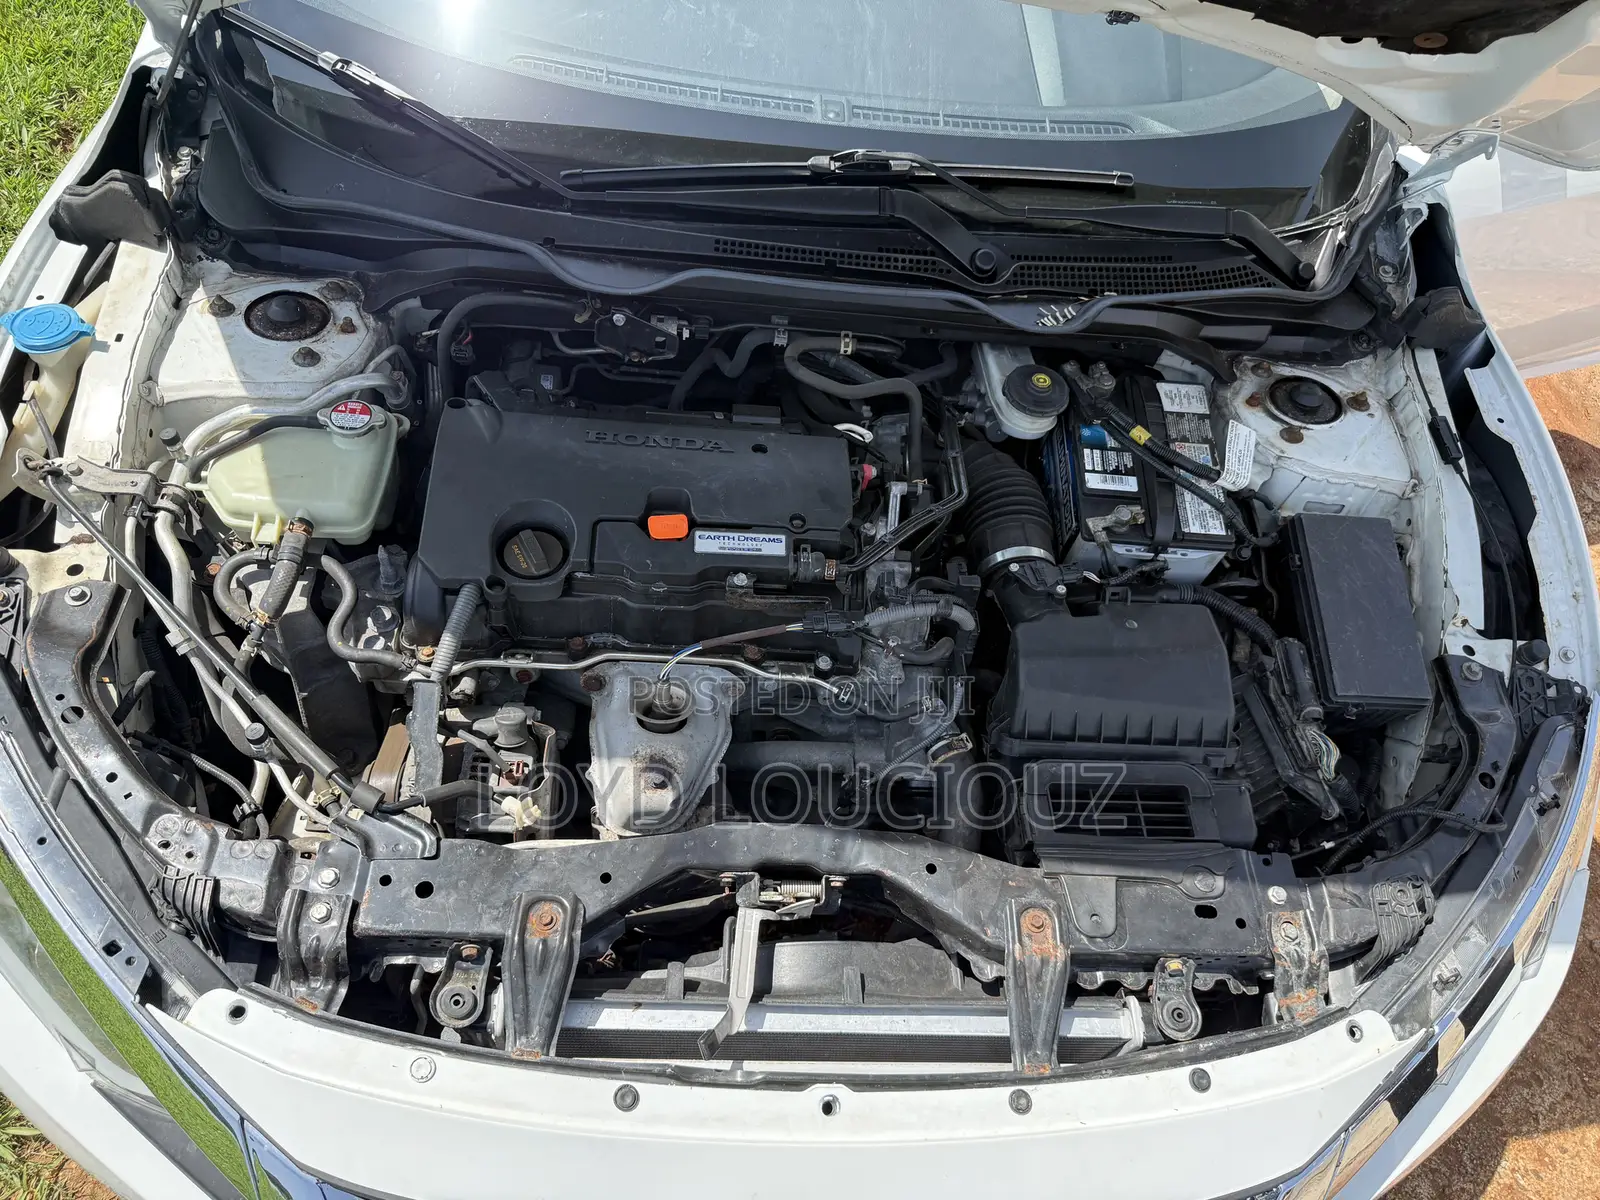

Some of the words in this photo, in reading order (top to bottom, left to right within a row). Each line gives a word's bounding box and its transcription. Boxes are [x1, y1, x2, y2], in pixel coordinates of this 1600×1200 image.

[585, 430, 734, 453] HONDA
[698, 534, 735, 542] EARTH
[737, 535, 783, 543] DREAMS
